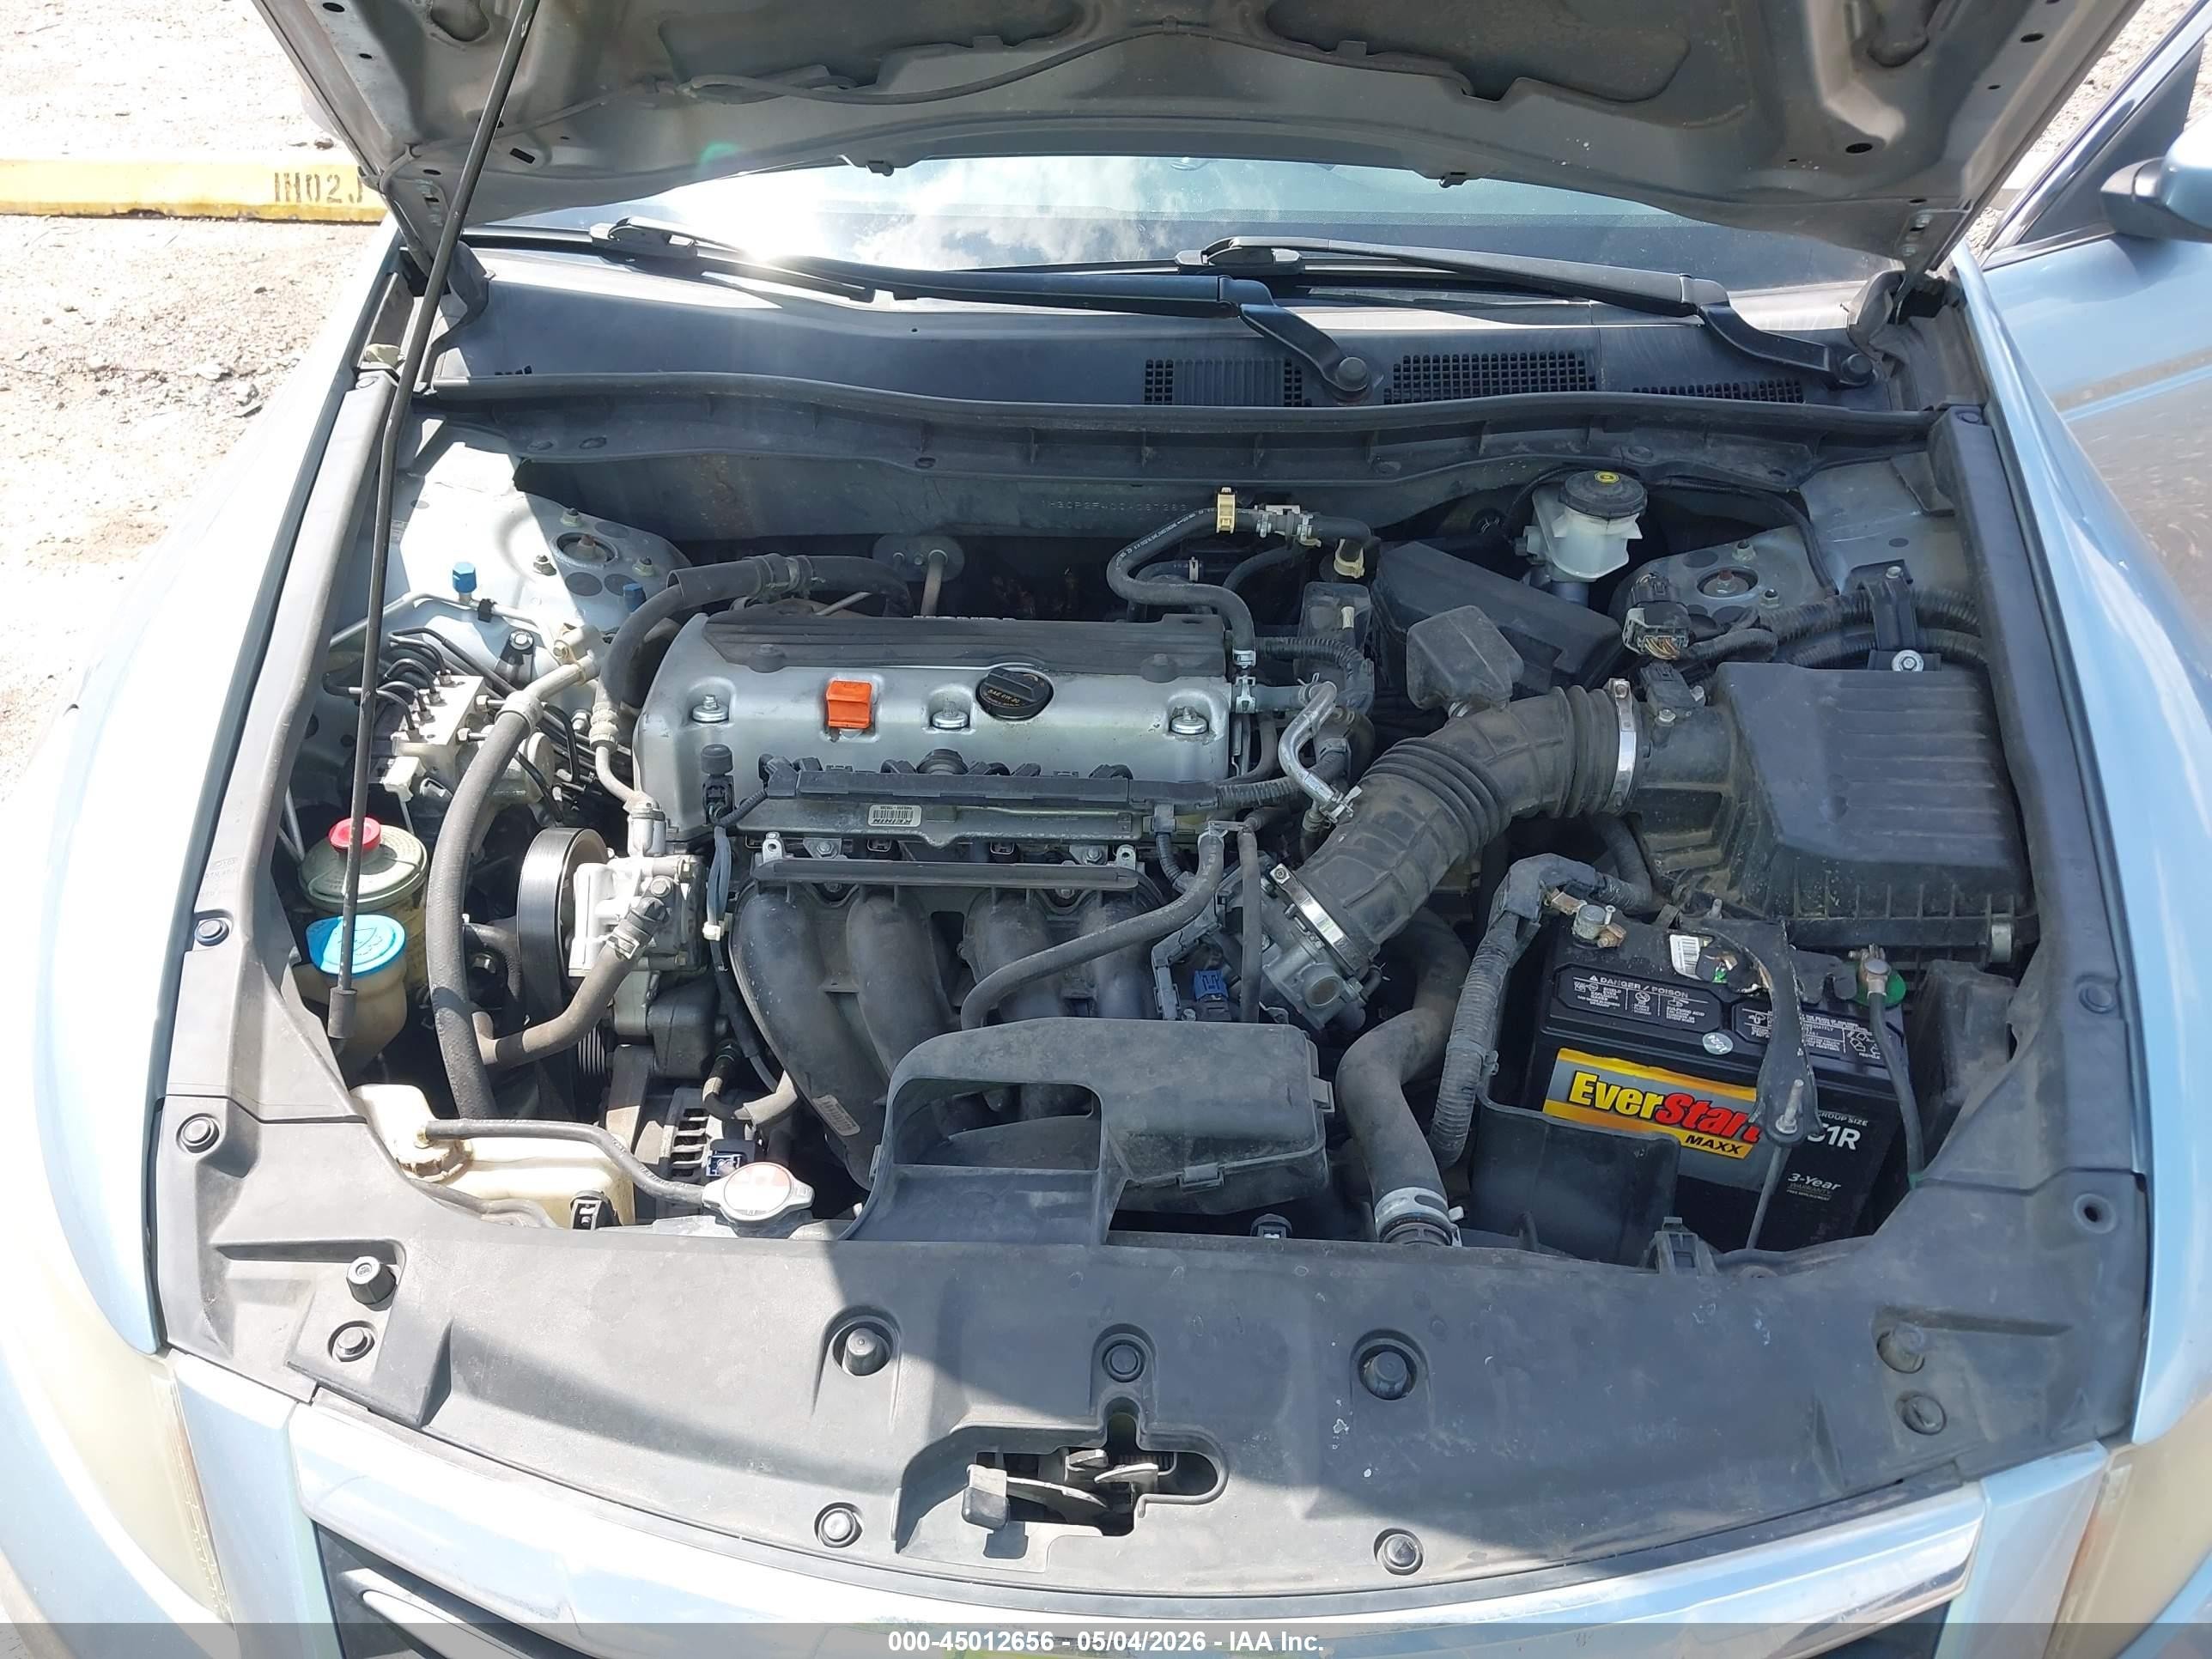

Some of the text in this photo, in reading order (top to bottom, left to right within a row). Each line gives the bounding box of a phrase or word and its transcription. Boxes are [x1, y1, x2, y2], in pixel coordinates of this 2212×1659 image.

[1600, 976, 1641, 990] DANGER
[1651, 987, 1689, 1000] POISON
[1847, 1116, 1869, 1127] SIZE
[1685, 1134, 1742, 1155] MAXX
[1787, 1172, 1842, 1191] 3-Year
